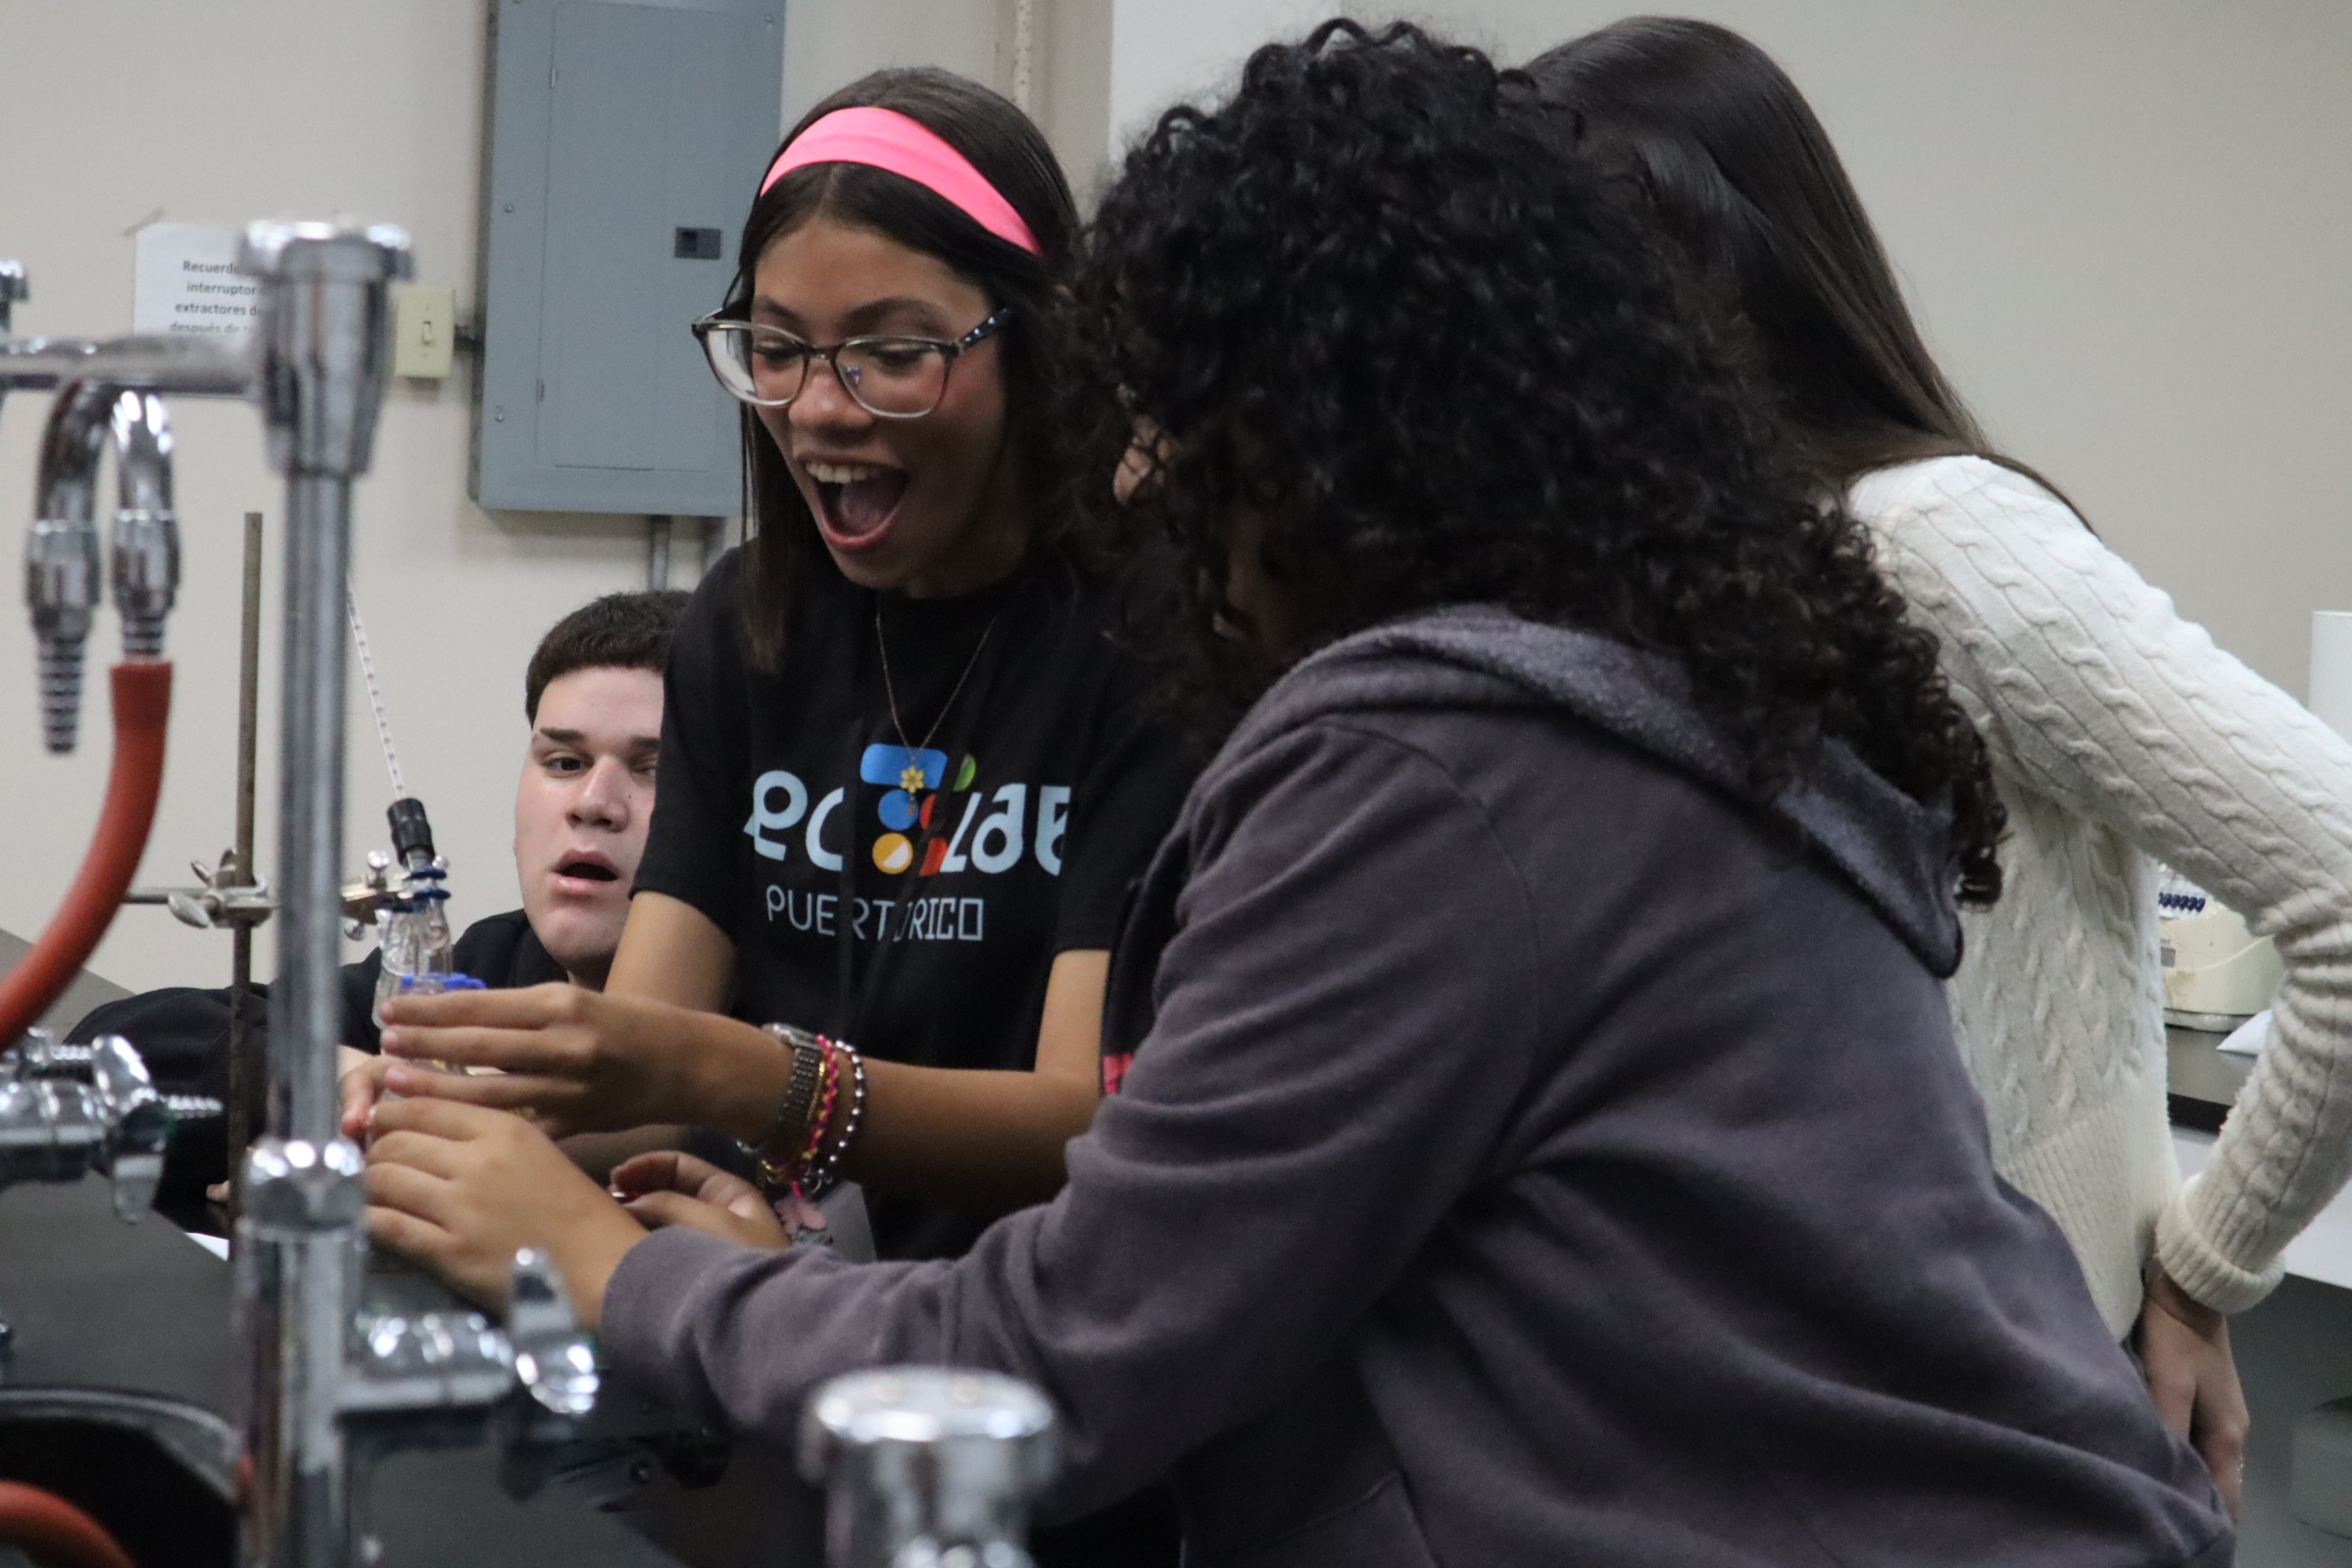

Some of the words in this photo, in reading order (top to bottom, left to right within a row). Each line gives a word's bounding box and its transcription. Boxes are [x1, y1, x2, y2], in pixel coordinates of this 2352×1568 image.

[182, 261, 240, 273] Recuerd
[174, 304, 246, 316] extractores
[765, 884, 912, 942] PUERT
[908, 897, 984, 941] RICO
